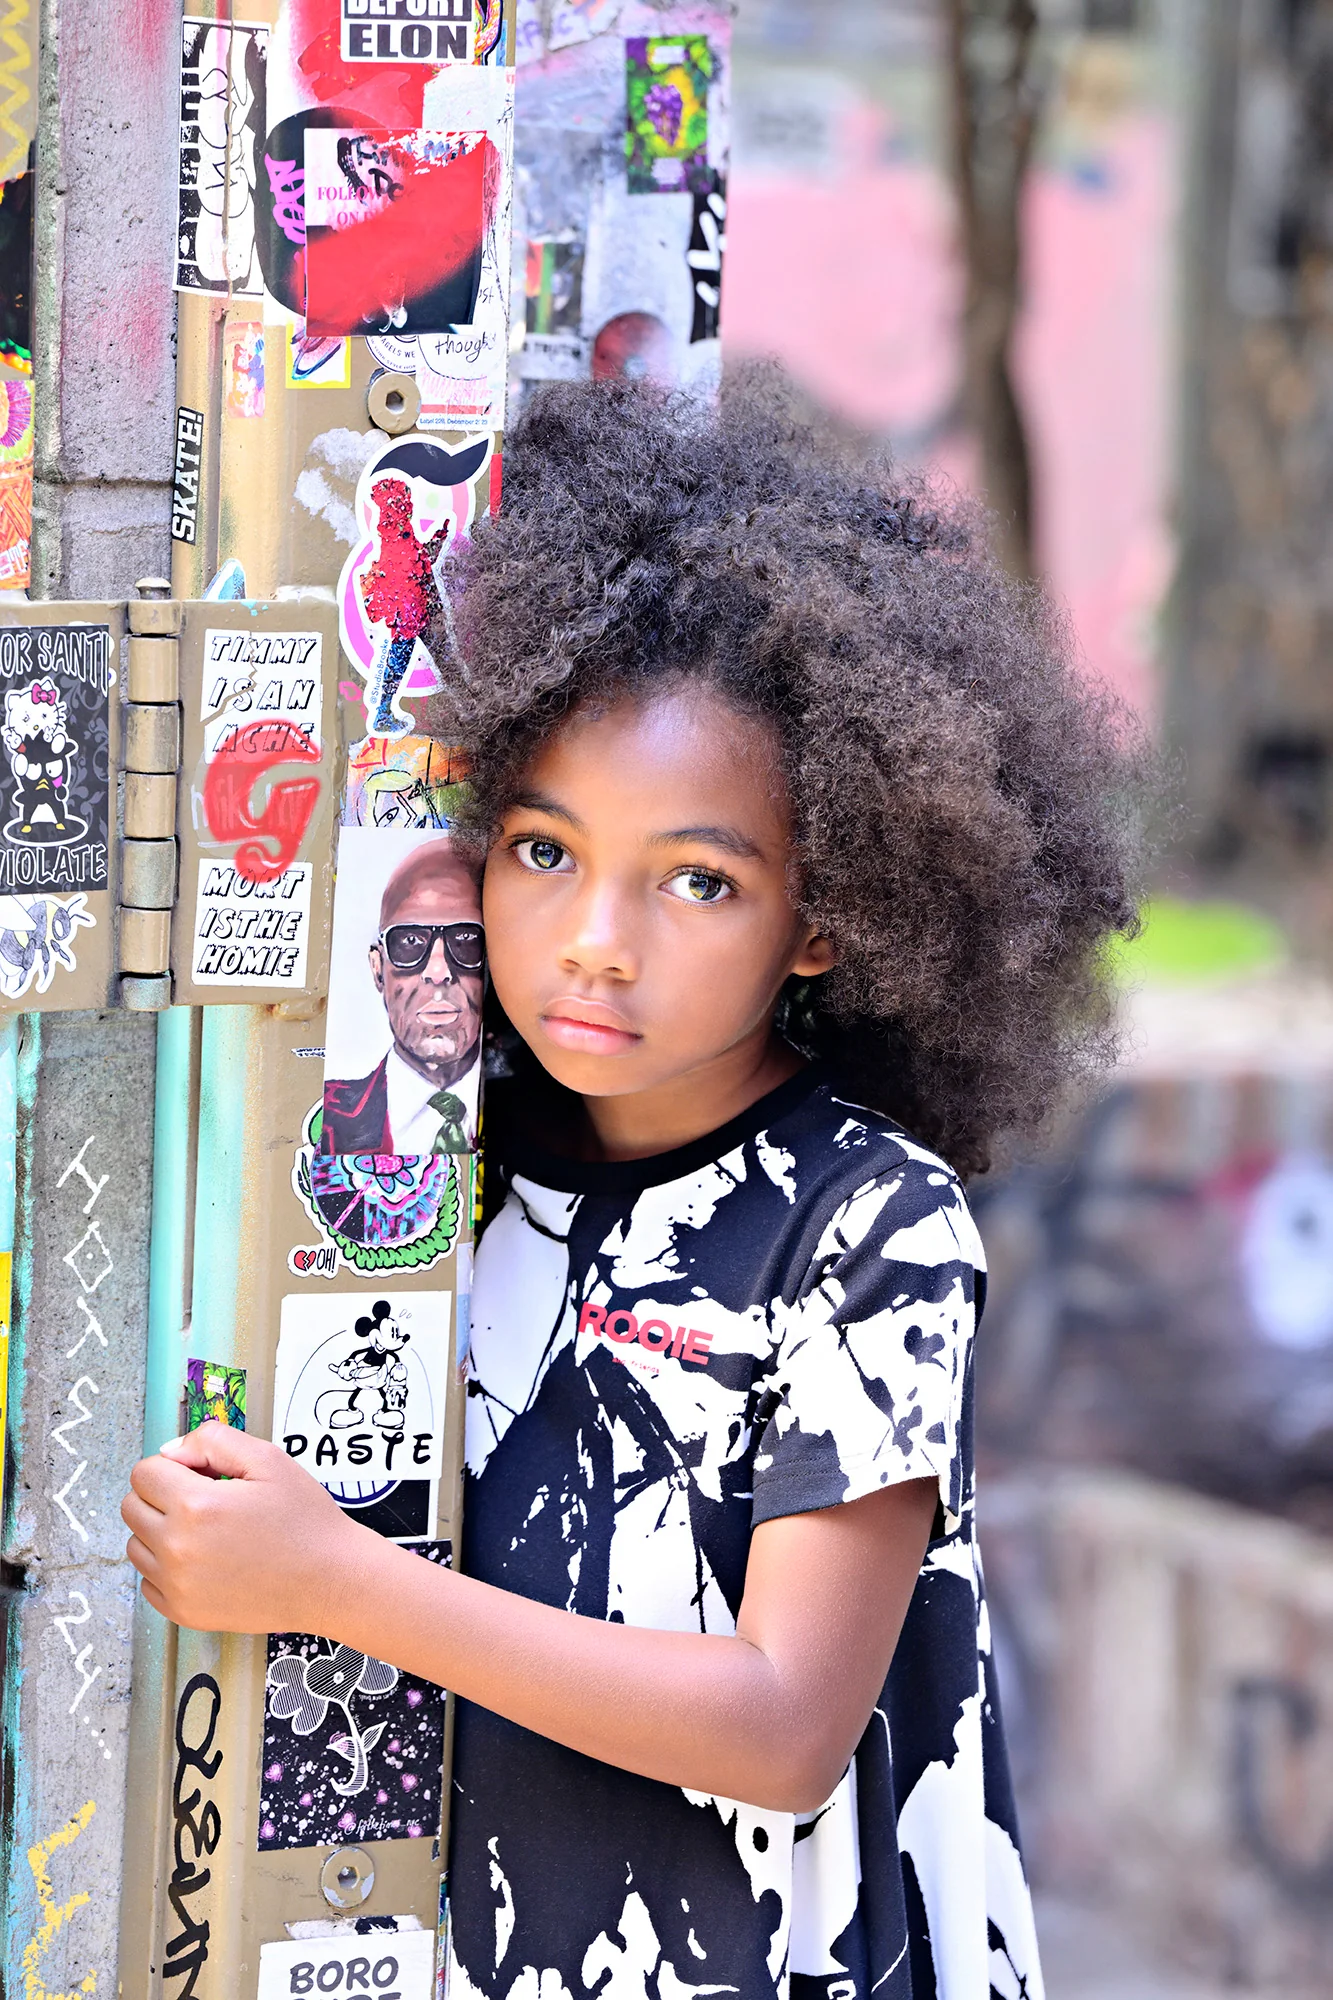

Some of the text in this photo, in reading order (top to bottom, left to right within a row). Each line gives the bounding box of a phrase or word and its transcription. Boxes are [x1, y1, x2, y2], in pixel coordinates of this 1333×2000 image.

[349, 23, 468, 60] ELON
[379, 335, 402, 357] AGELS
[172, 408, 203, 542] SKATE!
[37, 630, 110, 698] SANTI
[211, 635, 318, 665] TIMMY
[369, 638, 390, 705] @StudioBrooke
[212, 721, 316, 755] ACHE
[202, 866, 305, 899] MORT
[196, 943, 300, 978] HOMIE
[316, 1247, 337, 1274] OH!
[578, 1301, 714, 1366] ROOIE
[290, 1955, 399, 1995] BORO
